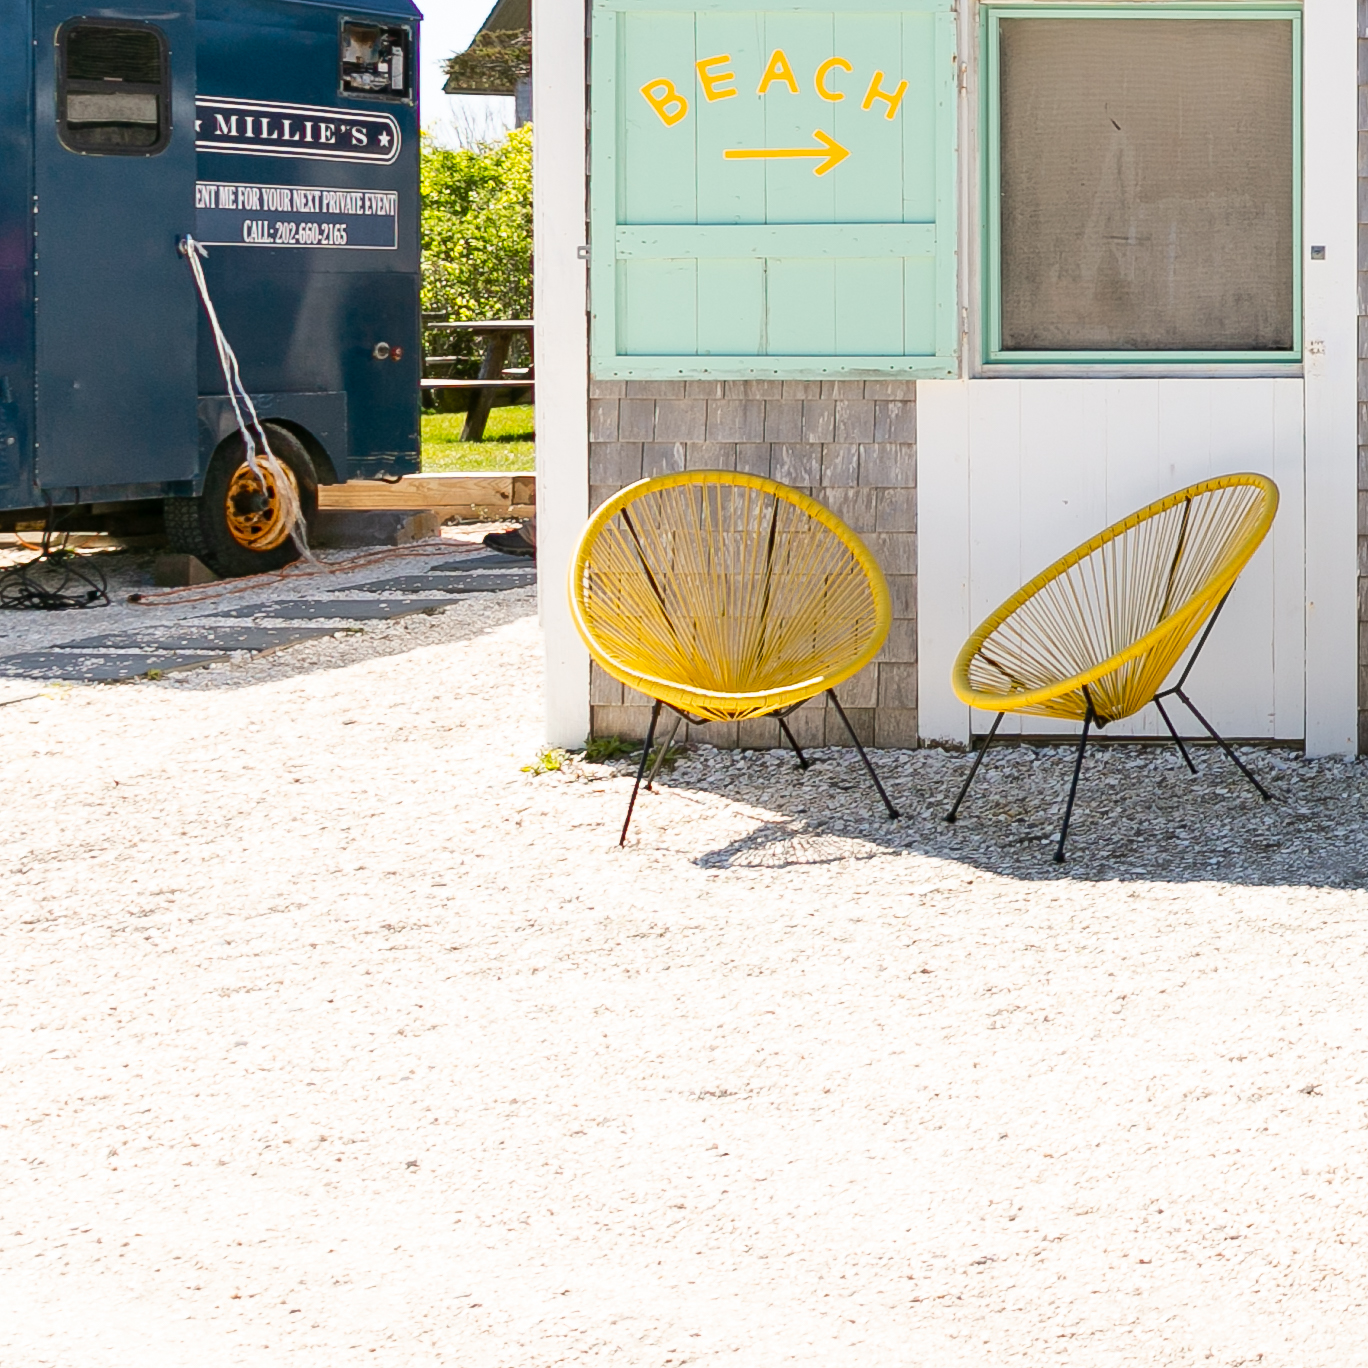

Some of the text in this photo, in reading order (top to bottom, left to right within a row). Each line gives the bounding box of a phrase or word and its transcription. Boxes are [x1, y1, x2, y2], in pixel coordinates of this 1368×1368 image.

[639, 48, 909, 128] BEACH
[214, 113, 368, 146] MILLIE'S
[195, 185, 397, 216] ENT ME FOR YOUR NEXT PRIVATE EVENT
[243, 220, 347, 245] CALL: 202-660-2165
